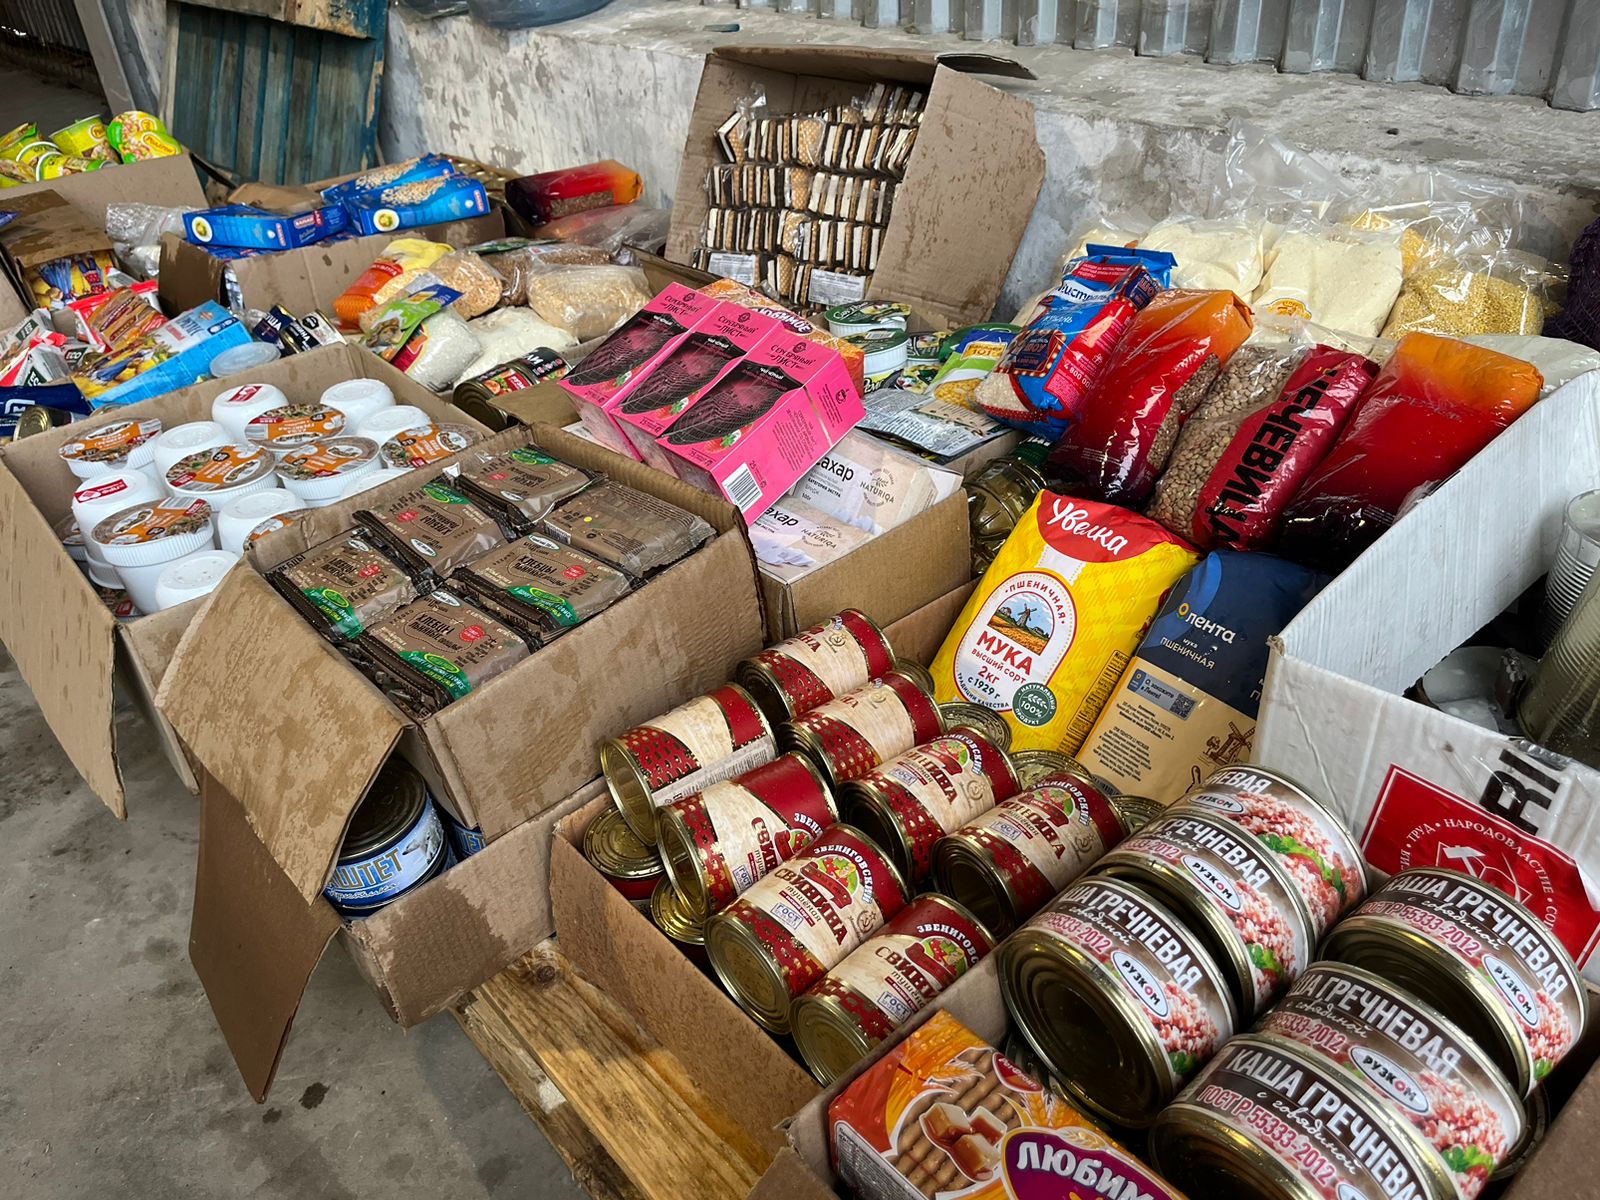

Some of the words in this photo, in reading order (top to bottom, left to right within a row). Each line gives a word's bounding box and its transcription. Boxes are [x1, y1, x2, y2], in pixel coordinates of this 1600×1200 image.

[666, 303, 686, 317] ЛИСТ
[719, 325, 742, 338] ЛИСТ
[771, 354, 798, 371] ЛИСТ
[1205, 370, 1336, 543] ЕЧЕВИЦА
[860, 481, 895, 503] NATURIQA
[801, 528, 837, 549] NATURIQA
[1047, 498, 1129, 555] Увелка
[519, 555, 557, 575] ХЛЕБЦЫ
[1009, 579, 1065, 621] ПШЕНИЧНАЯ
[415, 613, 455, 635] ХЛЕБЦЫ
[1185, 612, 1238, 645] лента
[976, 631, 1033, 676] МУКА
[1160, 636, 1217, 670] ПШЕНИЧНАЯ
[1182, 637, 1199, 649] мука
[971, 648, 1004, 671] ВЫСШИЙ
[1003, 668, 1027, 684] СОРТ
[957, 672, 977, 700] ТРАДИЦИИ
[977, 699, 1010, 709] КАЧЕСТВА
[973, 678, 996, 695] 1929
[1020, 684, 1056, 710] НАТУРАЛЬНЫЙ
[1015, 708, 1040, 725] ПРОДУКТ
[1020, 700, 1043, 718] 100%
[1406, 823, 1437, 842] ТРУД
[1443, 818, 1555, 894] НАРОДОВЛАСТИЕ
[739, 865, 751, 886] ГОСТ
[814, 845, 873, 905] ЗВЕНИГОВСКИЙ
[1193, 862, 1233, 900] РУЗКОМ
[774, 868, 848, 946] СВИНИНА
[776, 902, 801, 922] ГОСТ
[785, 885, 822, 922] тушёная
[1095, 890, 1203, 993] ГРЕЧНЕВАЯ
[1398, 904, 1483, 957] 55333-2012
[1421, 899, 1506, 950] говядиной
[1443, 884, 1569, 998] ГРЕЧНЕВАЯ
[1121, 960, 1161, 1006] РУЗКОМ
[1492, 965, 1533, 1014] РУЗКОМ
[884, 992, 911, 1016] ГОСТ
[1296, 1000, 1374, 1039] говядиной
[1315, 976, 1462, 1079] ГРЕЧНЕВАЯ
[1225, 1047, 1305, 1100] КАША
[1362, 1054, 1418, 1102] РУЗКОМ
[1197, 1084, 1238, 1109] ГОСТ
[1234, 1095, 1249, 1115] Р
[1248, 1104, 1337, 1187] 55333-2012
[1256, 1090, 1267, 1099] с
[1271, 1101, 1358, 1176] говядиной
